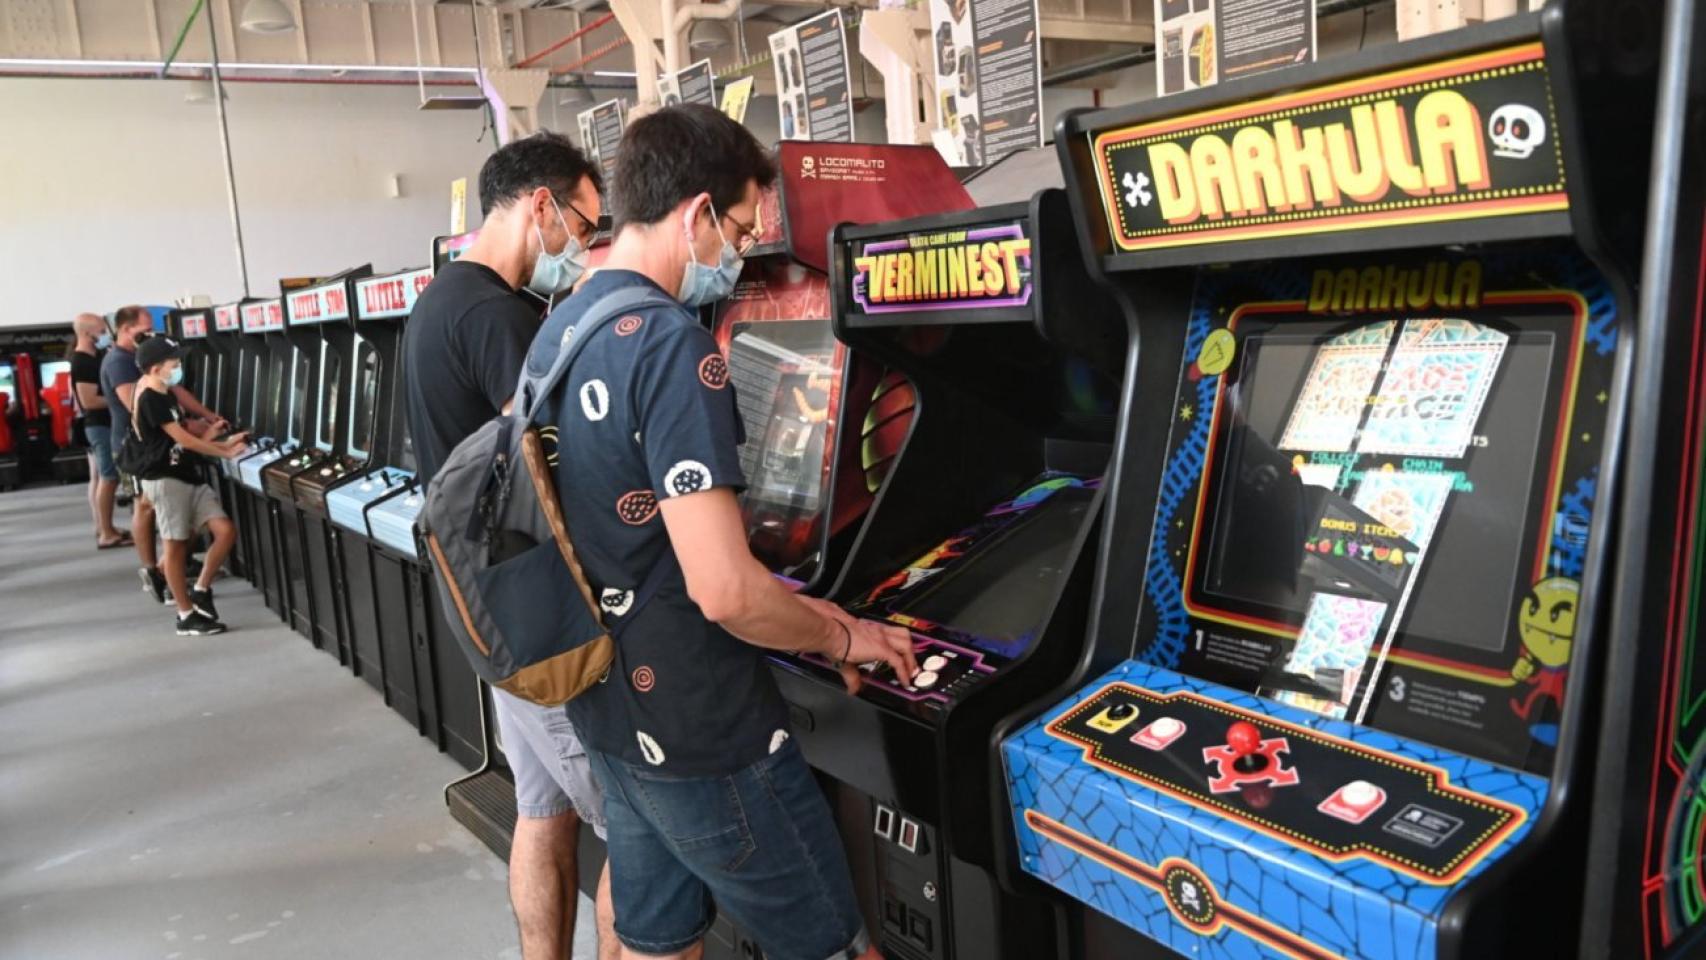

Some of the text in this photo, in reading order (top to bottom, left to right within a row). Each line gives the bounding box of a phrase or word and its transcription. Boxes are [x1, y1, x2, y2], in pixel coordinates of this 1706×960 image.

[819, 156, 885, 169] LOCOMALITO
[1148, 90, 1490, 225] DARKULA
[855, 238, 1031, 304] VERMINEST
[364, 279, 406, 313] LITTLE
[1308, 260, 1480, 313] DARKULA
[292, 292, 321, 321] LITTLE
[1320, 518, 1357, 532] BONUS
[1195, 629, 1205, 651] 1
[1388, 675, 1407, 702] 3
